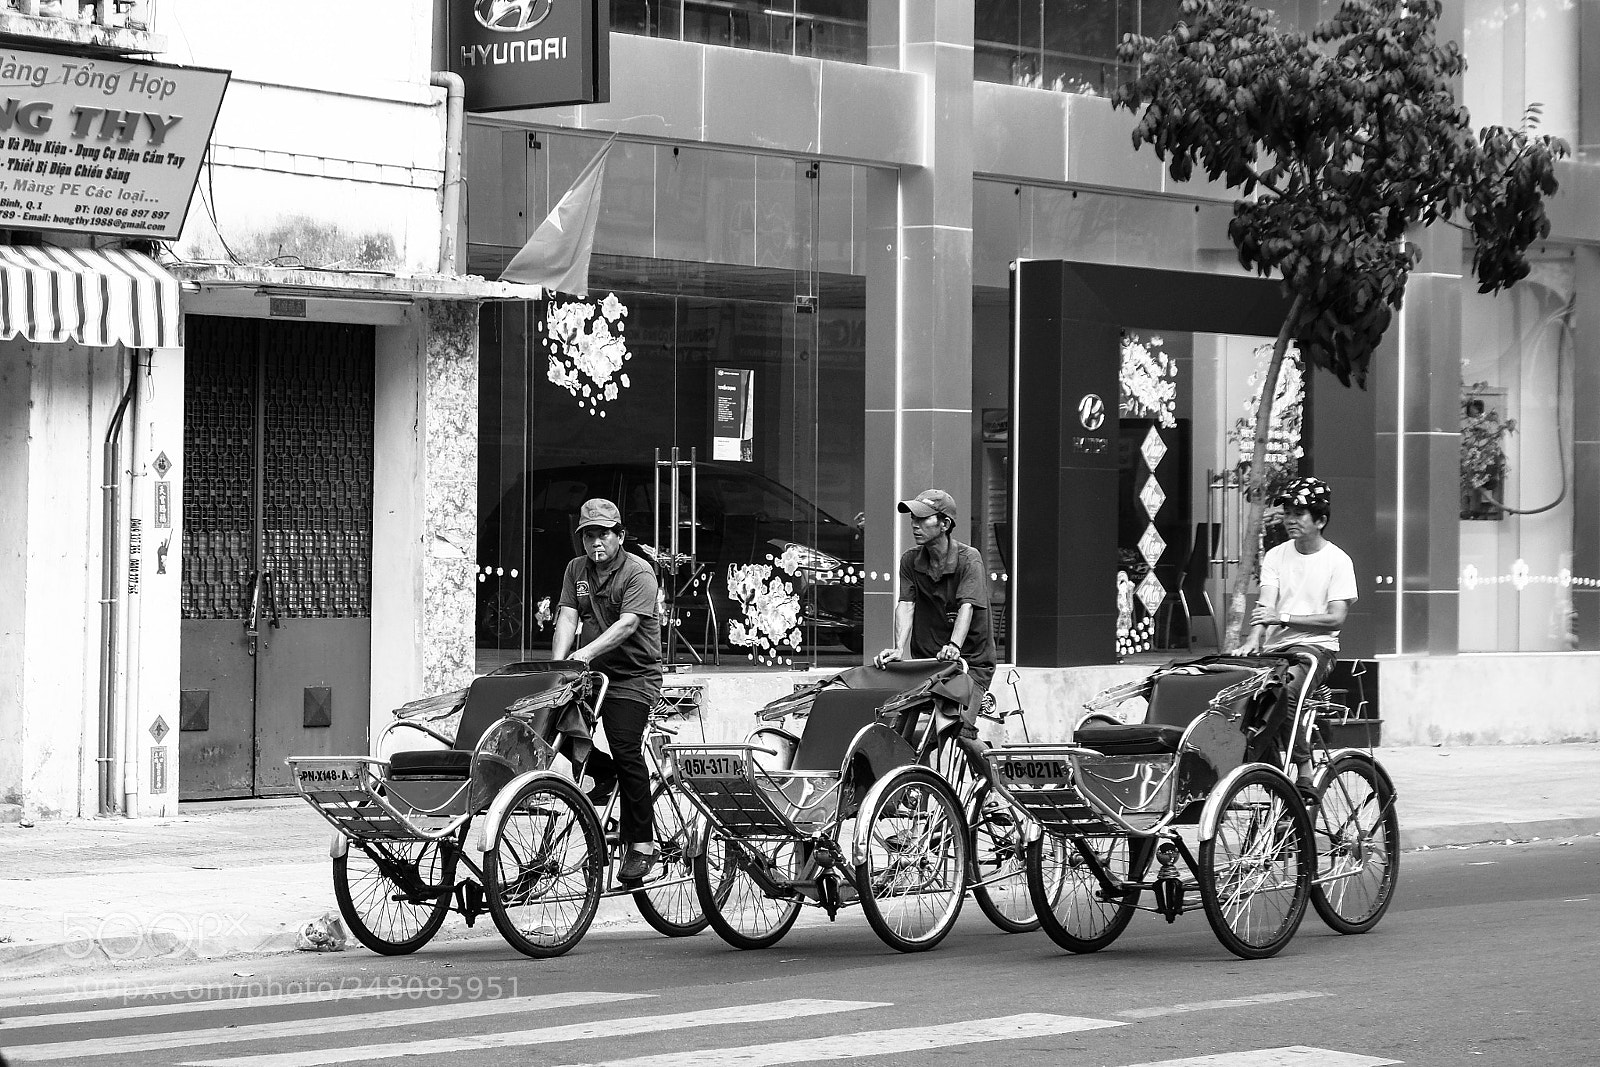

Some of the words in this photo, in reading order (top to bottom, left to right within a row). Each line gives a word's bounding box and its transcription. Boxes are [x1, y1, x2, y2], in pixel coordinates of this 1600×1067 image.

[460, 36, 567, 66] HYUNDAI
[0, 54, 49, 88] àng
[62, 62, 121, 96] Tổng
[128, 71, 177, 101] Hợp
[70, 104, 184, 147] THY
[21, 138, 42, 155] Phụ
[43, 140, 68, 157] Kiện
[74, 143, 101, 161] Dụng
[102, 145, 117, 162] Cụ
[166, 152, 186, 169] Tay
[7, 157, 35, 173] Thiết
[35, 160, 49, 176] Bị
[104, 166, 131, 185] Sáng
[13, 179, 55, 196] Màng
[60, 182, 81, 196] PE
[85, 184, 113, 199] Các
[22, 211, 52, 223] Email:
[74, 204, 91, 214] ĐT:
[93, 205, 114, 216] (08)
[115, 207, 129, 217] 66
[131, 208, 150, 218] 897
[151, 210, 171, 220] 897
[684, 758, 729, 777] Q5X-317
